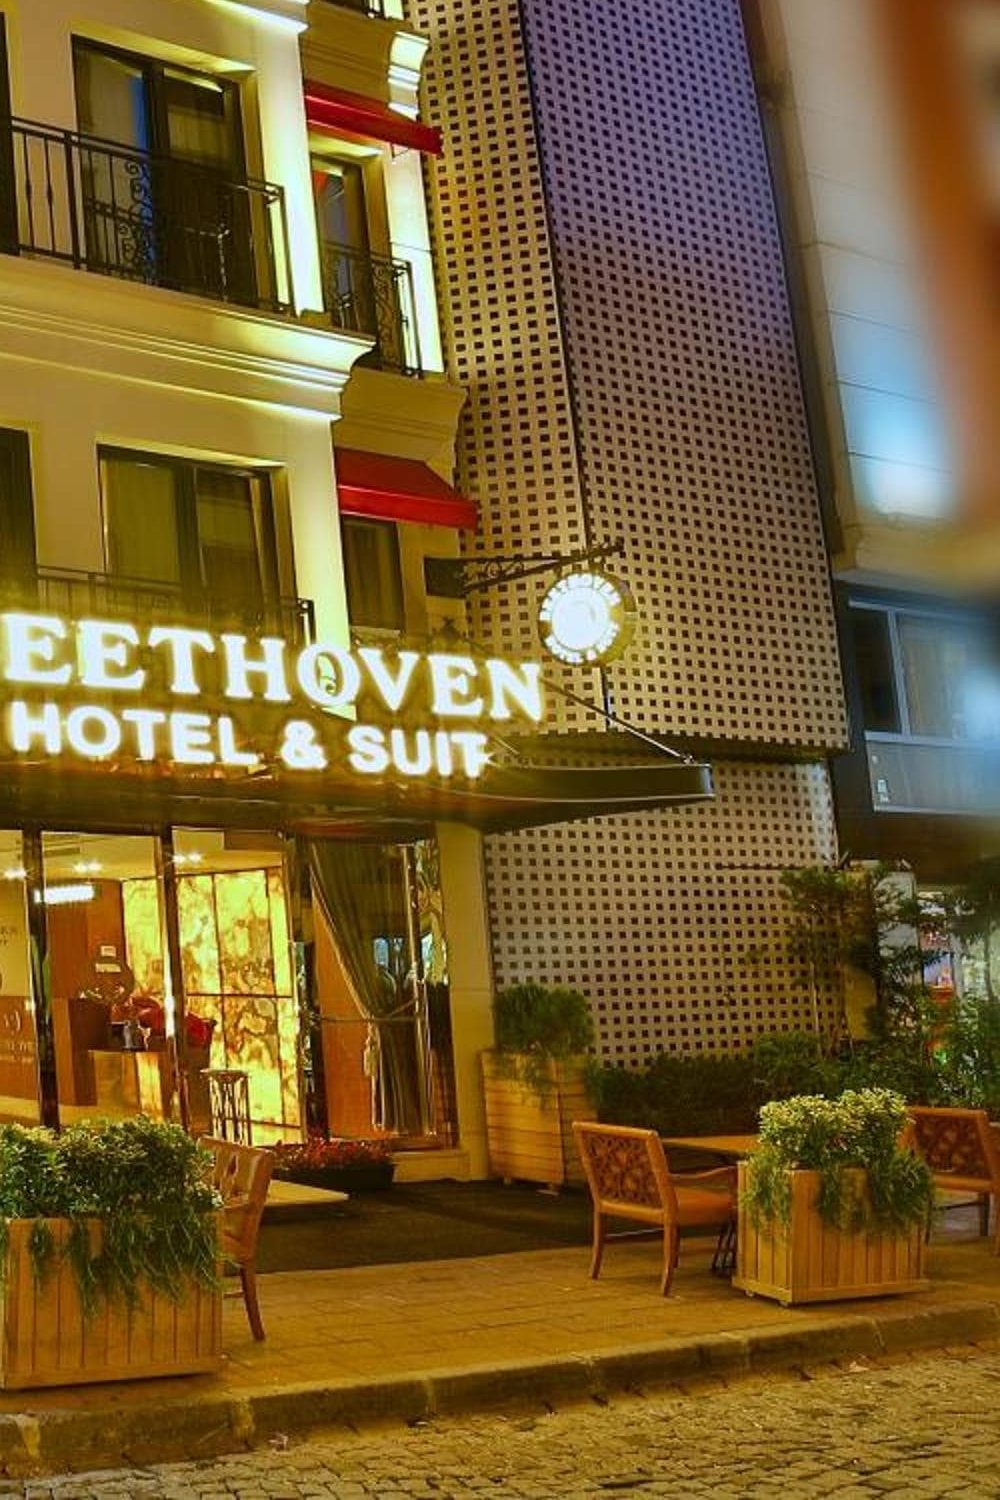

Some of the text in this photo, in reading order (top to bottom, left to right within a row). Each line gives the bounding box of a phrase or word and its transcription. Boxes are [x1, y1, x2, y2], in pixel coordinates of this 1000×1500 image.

[11, 701, 488, 779] HOTEL & SUIT
